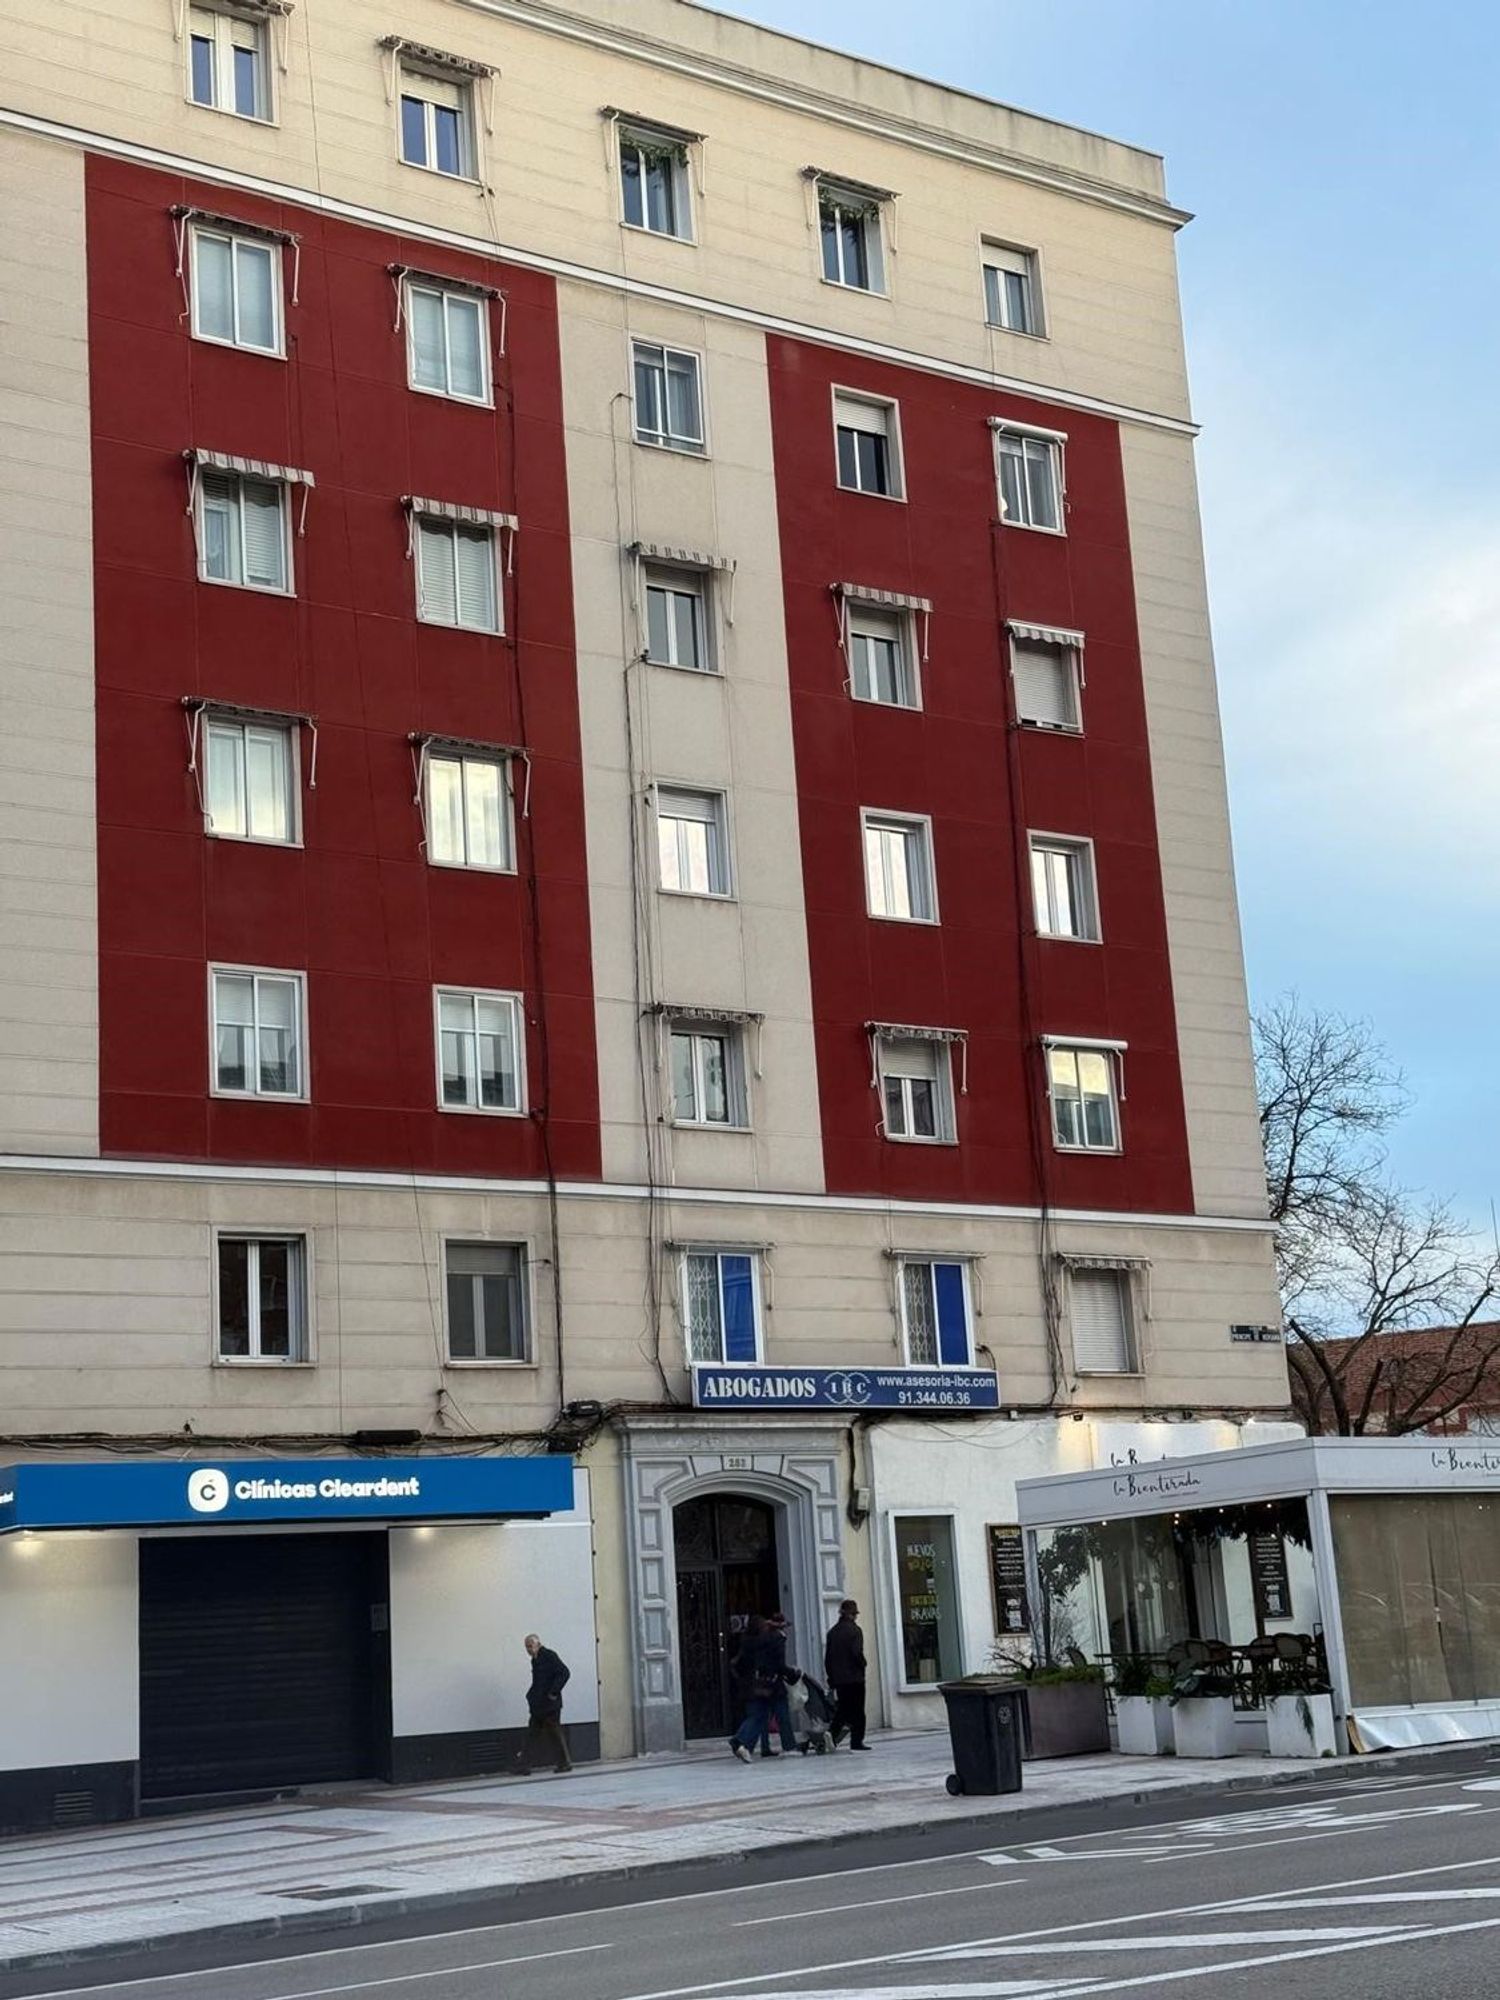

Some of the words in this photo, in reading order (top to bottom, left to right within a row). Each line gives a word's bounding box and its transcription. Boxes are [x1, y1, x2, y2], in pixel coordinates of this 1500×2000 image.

[703, 1377, 817, 1398] ABOGADOS
[877, 1374, 996, 1388] www.asesoria-ibc.com
[898, 1391, 971, 1405] 91.344.06.36
[234, 1478, 317, 1500] Clínicas
[318, 1476, 420, 1499] Cleardent
